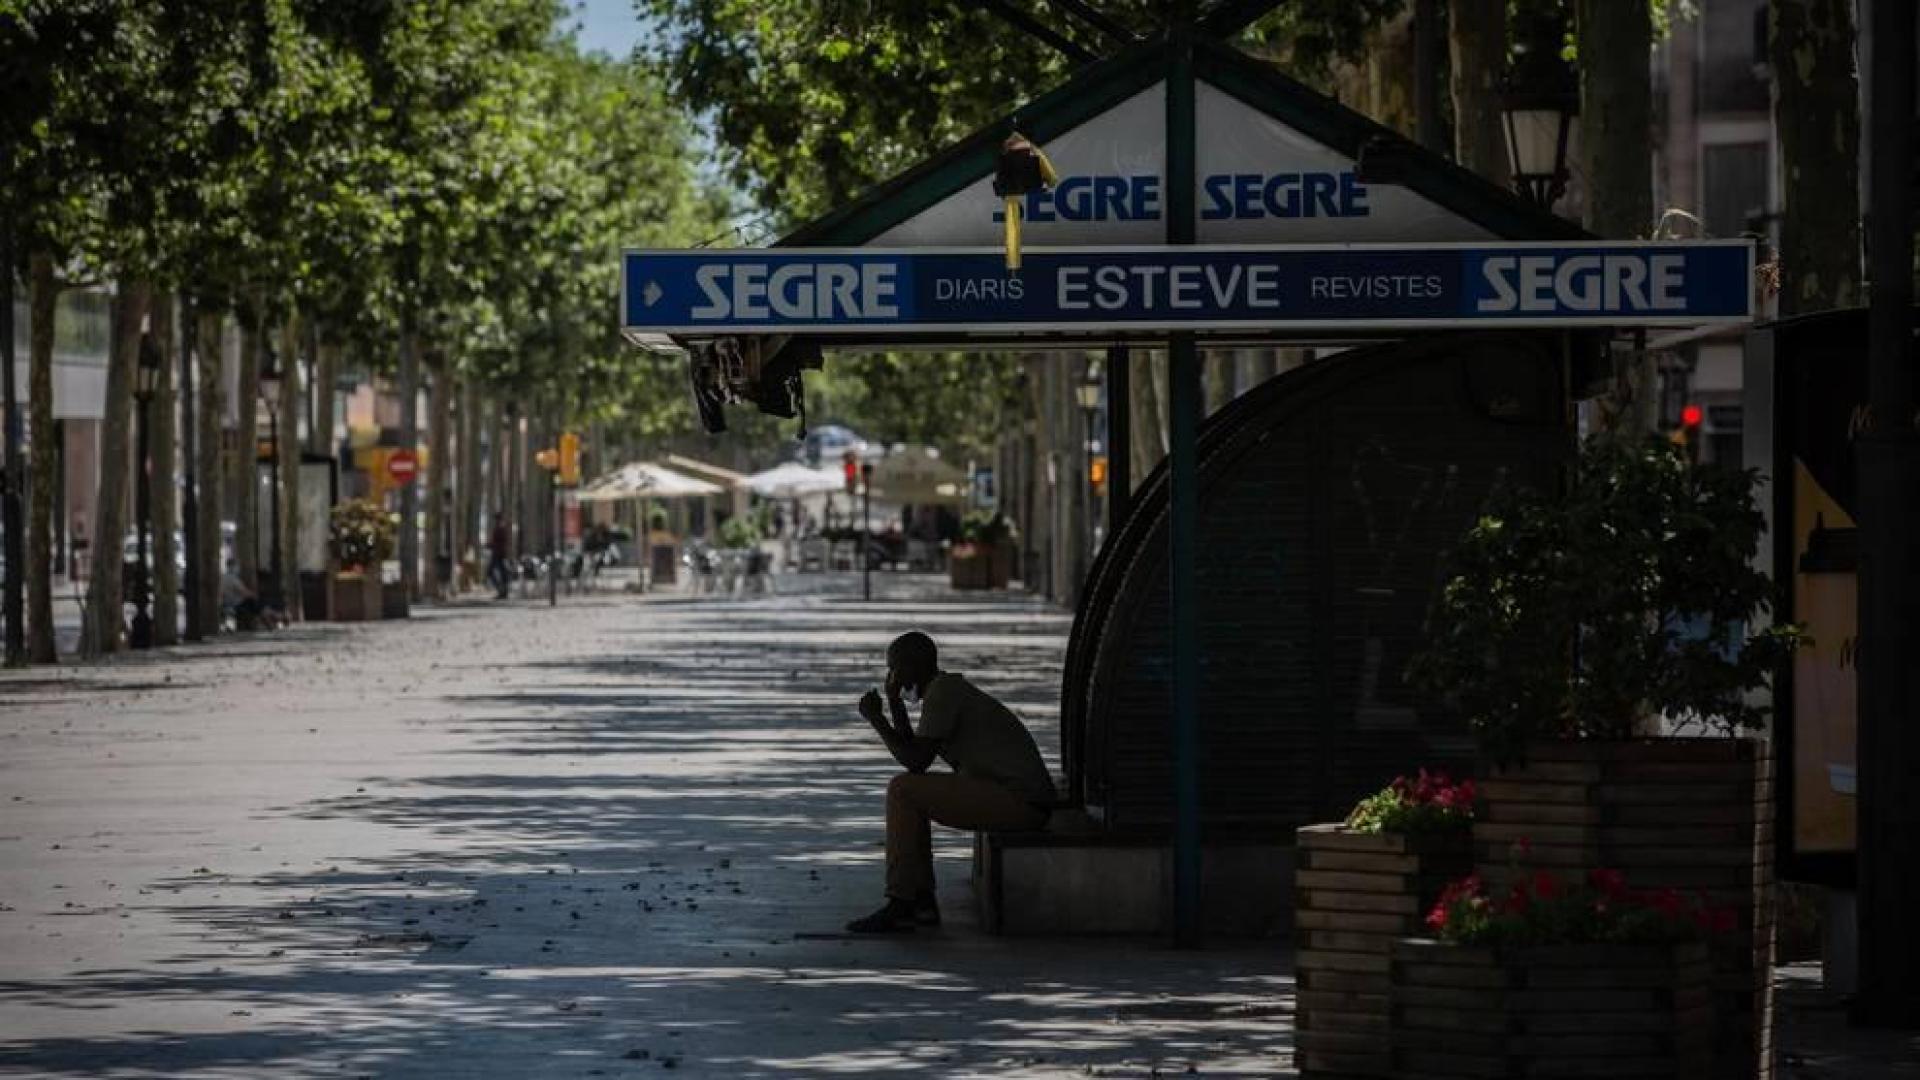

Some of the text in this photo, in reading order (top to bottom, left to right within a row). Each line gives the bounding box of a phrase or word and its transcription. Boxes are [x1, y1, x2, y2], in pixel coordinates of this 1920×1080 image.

[993, 176, 1160, 221] EGRE
[1202, 173, 1369, 219] SEGRE
[692, 256, 1687, 318] SEGRE DIARIS ESTEVE REVISTES SEGRE
